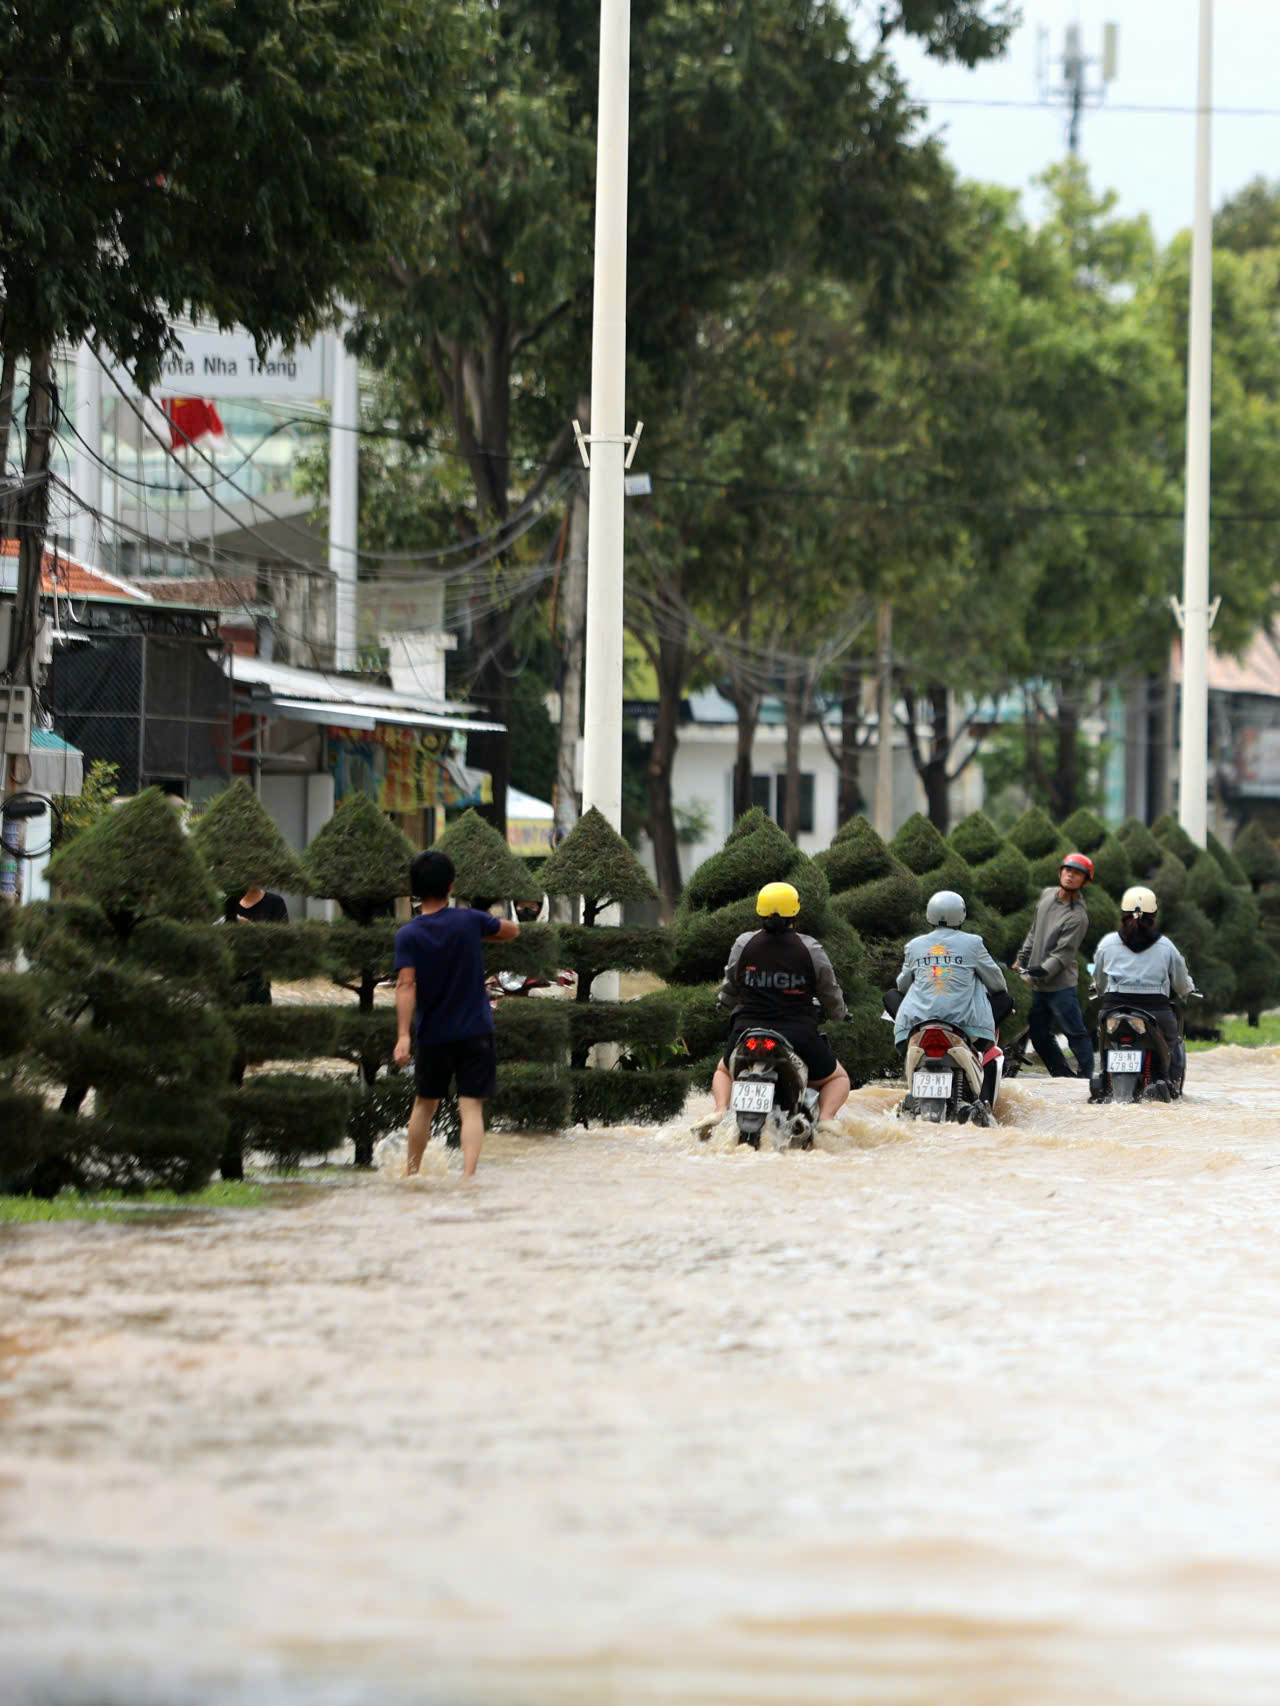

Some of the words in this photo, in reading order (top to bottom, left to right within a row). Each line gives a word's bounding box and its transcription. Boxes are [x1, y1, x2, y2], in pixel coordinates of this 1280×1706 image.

[203, 357, 237, 377] Nha
[920, 1074, 947, 1085] 79-N1
[917, 1085, 949, 1097] 171.81
[733, 1096, 770, 1110] 417.98
